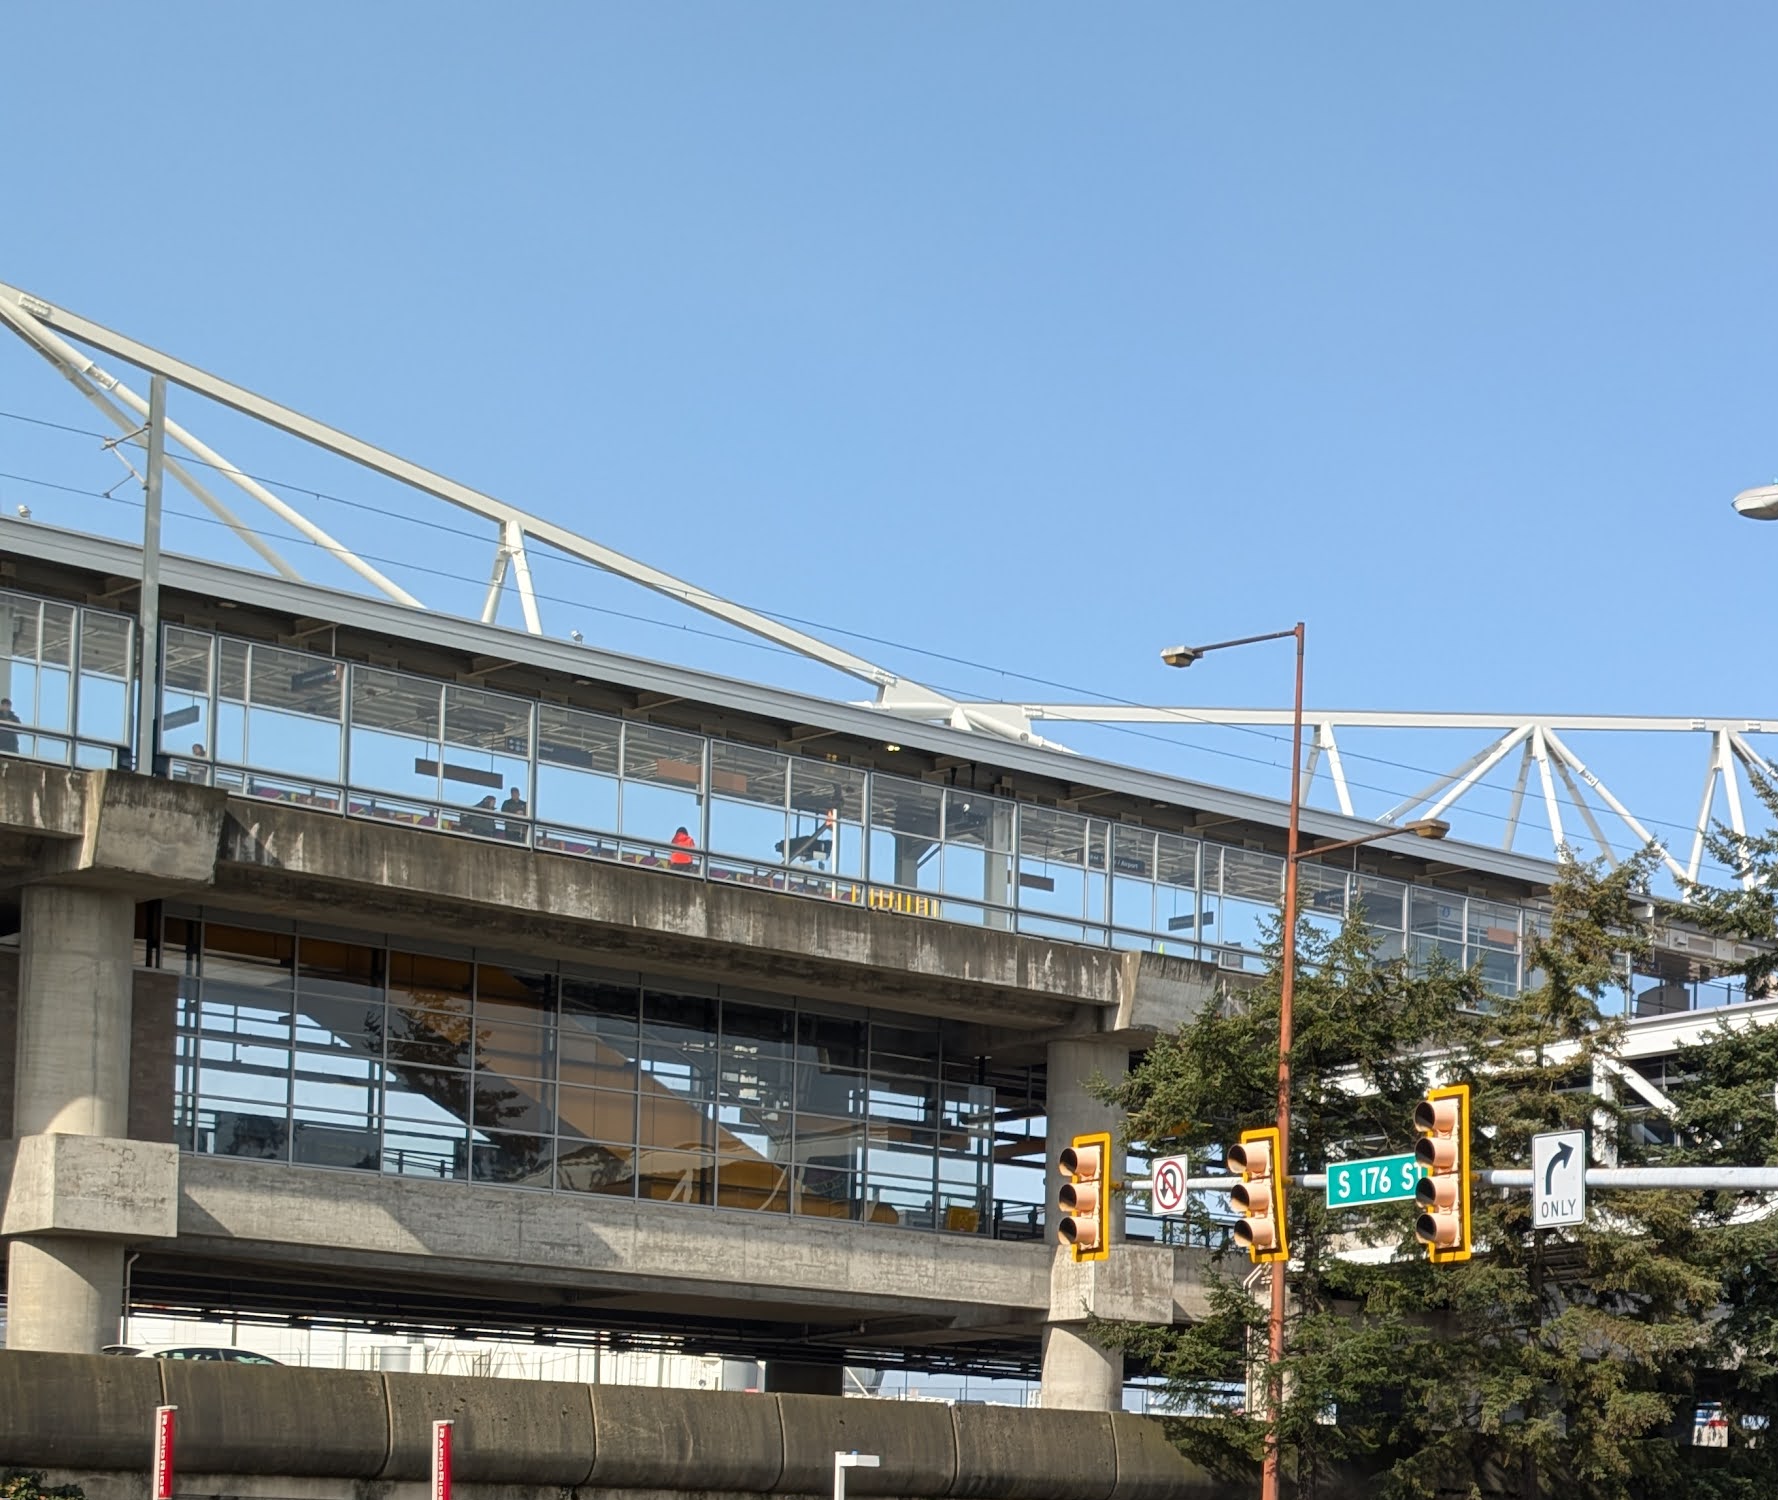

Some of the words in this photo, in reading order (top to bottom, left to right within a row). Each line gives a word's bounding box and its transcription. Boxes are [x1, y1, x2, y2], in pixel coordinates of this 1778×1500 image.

[1338, 1170, 1351, 1199] S
[1360, 1165, 1392, 1196] 176
[1541, 1198, 1577, 1219] ONLY
